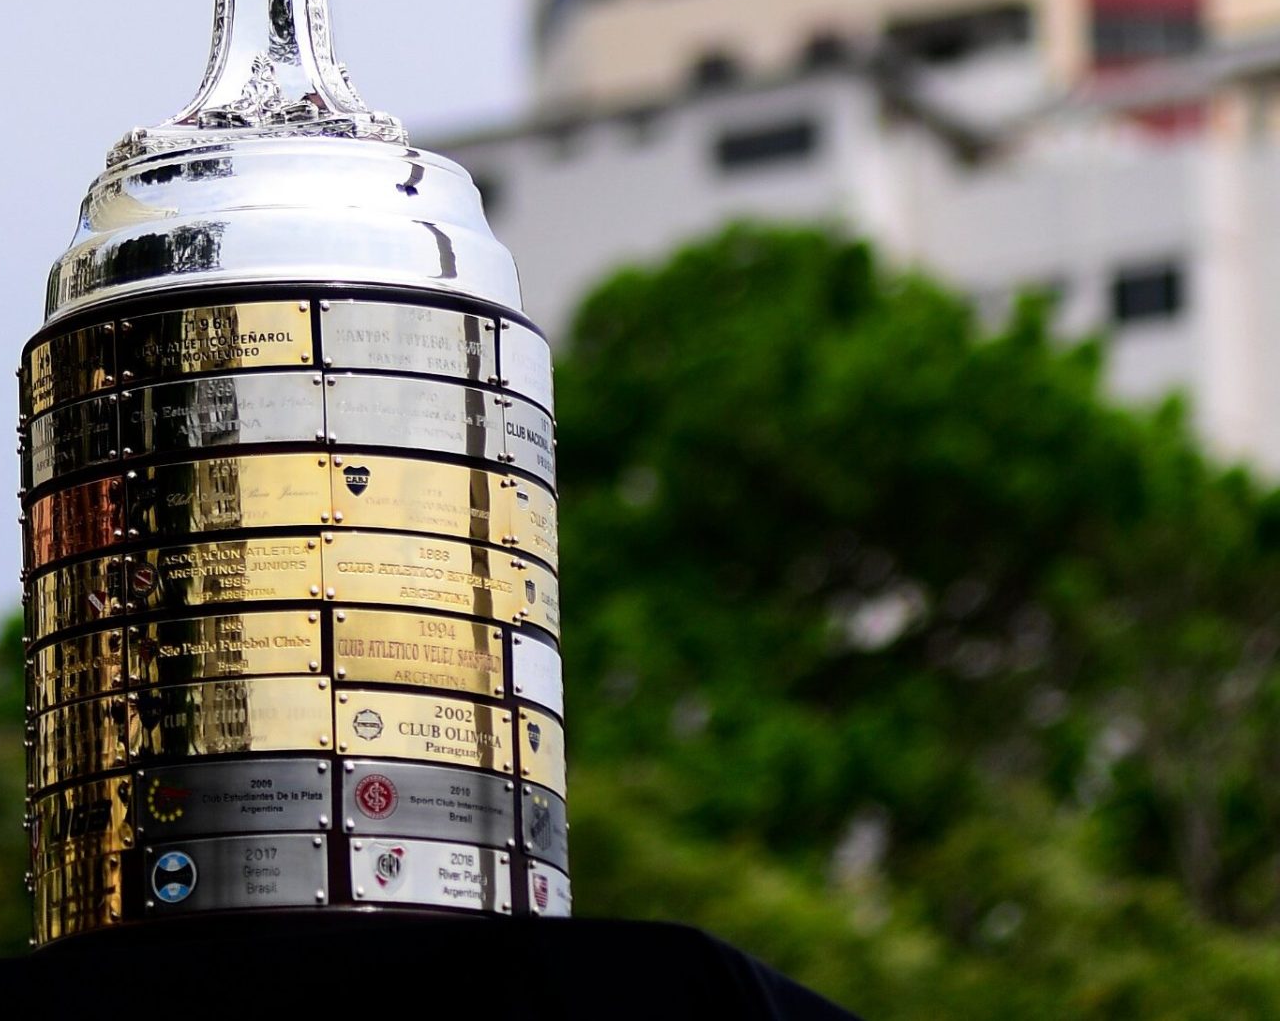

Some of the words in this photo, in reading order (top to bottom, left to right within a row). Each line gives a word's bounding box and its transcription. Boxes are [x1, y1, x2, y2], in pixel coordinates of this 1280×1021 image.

[232, 331, 294, 348] PEÑAROL
[181, 347, 260, 363] MONTEVIDEO
[506, 421, 526, 441] CLUB
[345, 474, 370, 486] CABJ
[162, 548, 240, 567] ASOCIACION
[244, 545, 311, 558] ATLETICA
[167, 563, 247, 580] ARGENTINOS
[250, 560, 308, 572] JUNIORS
[337, 561, 375, 574] CLUB
[377, 563, 445, 580] ATLETICO
[400, 585, 471, 606] ARGENTINA
[418, 620, 456, 640] 1994
[158, 643, 181, 659] São
[273, 635, 312, 648] Clube
[338, 638, 364, 657] CLUB
[369, 641, 419, 661] ATLETICO
[423, 645, 455, 666] VELEZ
[394, 670, 467, 690] ARGENTINA
[434, 705, 472, 723] 2002
[398, 722, 441, 739] CLUB
[445, 727, 503, 749] OLIMPIA
[425, 742, 483, 761] Paraguay
[250, 780, 273, 789] 2009
[202, 793, 221, 804] Club
[222, 792, 275, 803] Estudiantes
[277, 792, 289, 801] De
[301, 791, 323, 801] Plata
[410, 795, 434, 808] Sport
[435, 797, 456, 809] Club
[240, 805, 284, 814] Argentina
[449, 812, 473, 824] Brasil
[245, 848, 278, 861] 2017
[451, 853, 474, 867] 2018
[439, 867, 461, 881] River
[247, 882, 278, 895] Brasil
[443, 886, 487, 902] Argentina
